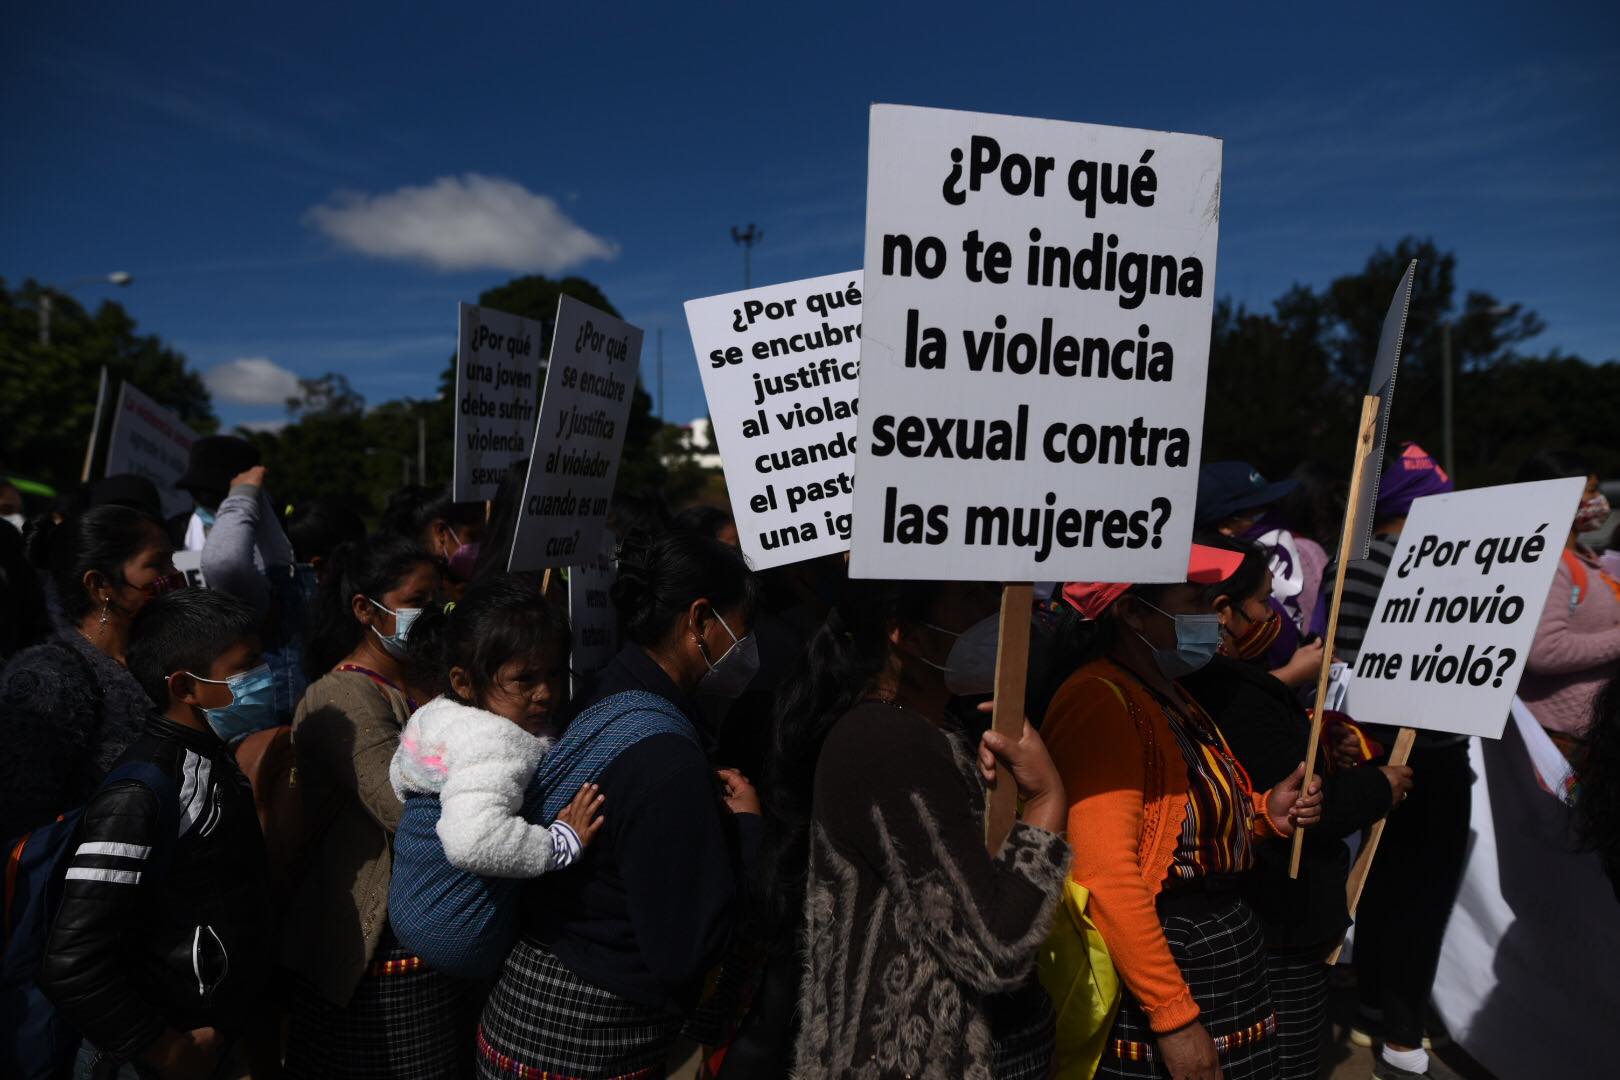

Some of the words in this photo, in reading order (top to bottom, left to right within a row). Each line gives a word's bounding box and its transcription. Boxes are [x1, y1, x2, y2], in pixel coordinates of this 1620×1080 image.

[943, 135, 1056, 206] ¿Por
[1067, 148, 1158, 219] qué
[882, 234, 947, 280] no
[963, 229, 1012, 285] te
[1028, 227, 1204, 310] indigna
[732, 298, 797, 333] ¿Por
[806, 281, 862, 318] qué
[472, 325, 503, 353] ¿Por
[506, 335, 531, 358] qué
[575, 320, 605, 353] ¿Por
[606, 332, 628, 362] qué
[709, 341, 743, 369] se
[905, 308, 947, 370] la
[962, 314, 1174, 383] violencia
[467, 362, 493, 383] una
[495, 364, 531, 392] joven
[562, 366, 577, 387] se
[580, 372, 625, 401] encubre
[752, 357, 862, 406] justific
[461, 392, 495, 417] debe
[499, 398, 532, 420] sufrir
[556, 411, 568, 438] y
[566, 406, 615, 440] justifica
[742, 409, 770, 439] al
[467, 428, 524, 453] violencia
[871, 404, 1029, 461] sexual
[1042, 416, 1190, 468] contra
[546, 445, 561, 473] al
[562, 450, 610, 478] violador
[528, 488, 576, 516] cuando
[578, 498, 592, 516] es
[594, 498, 607, 516] un
[749, 484, 778, 514] el
[785, 472, 856, 514] past
[759, 522, 818, 551] una
[884, 486, 949, 546] las
[965, 491, 1172, 563] mujeres?
[545, 531, 580, 557] cura?
[1398, 534, 1471, 579] ¿Por
[1475, 523, 1549, 575] qué
[1381, 586, 1425, 623] mi
[1424, 584, 1525, 625] novio
[1357, 651, 1402, 680] me
[1410, 643, 1517, 689] violó?
